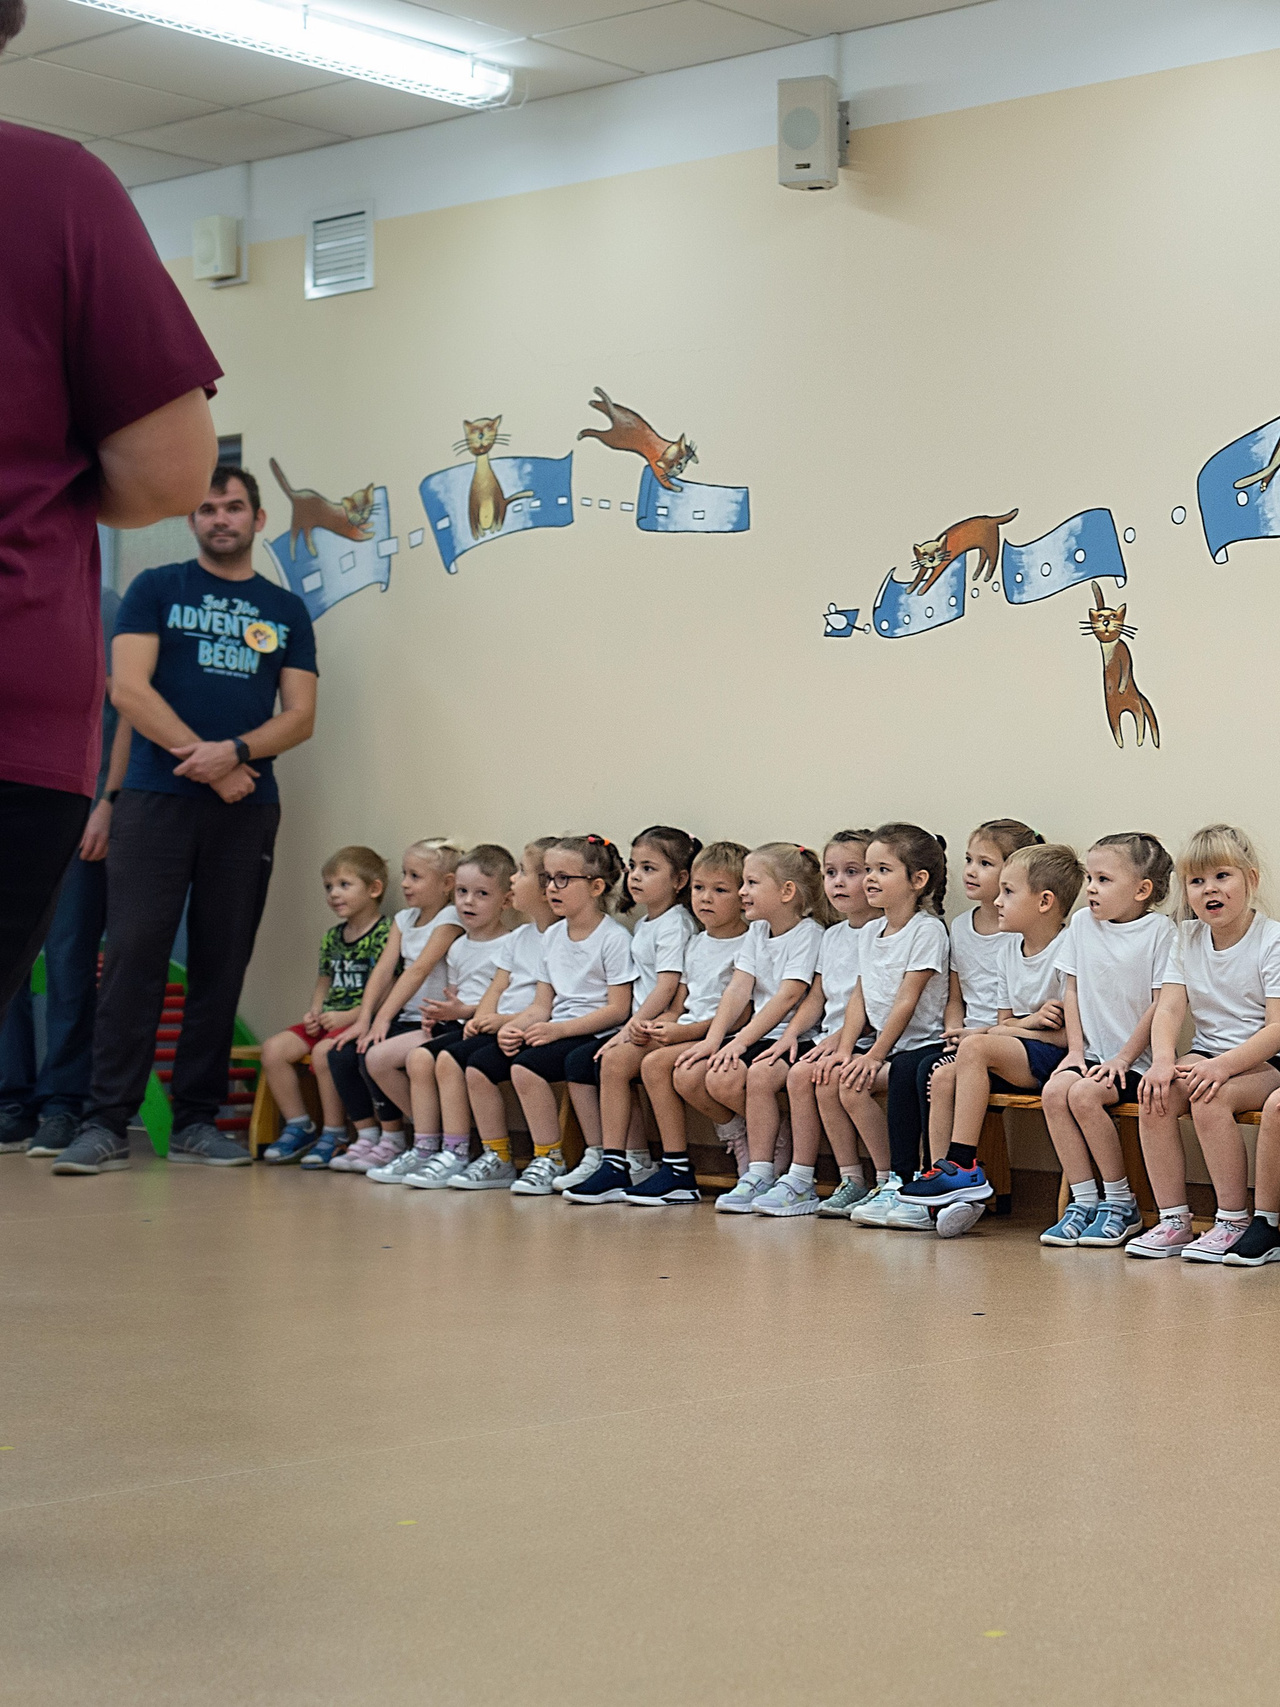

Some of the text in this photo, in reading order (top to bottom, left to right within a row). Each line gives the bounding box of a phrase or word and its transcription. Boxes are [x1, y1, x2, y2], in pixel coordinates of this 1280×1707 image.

[167, 603, 291, 649] ADVENTE
[198, 640, 260, 675] BEGIN
[332, 972, 364, 988] AME
